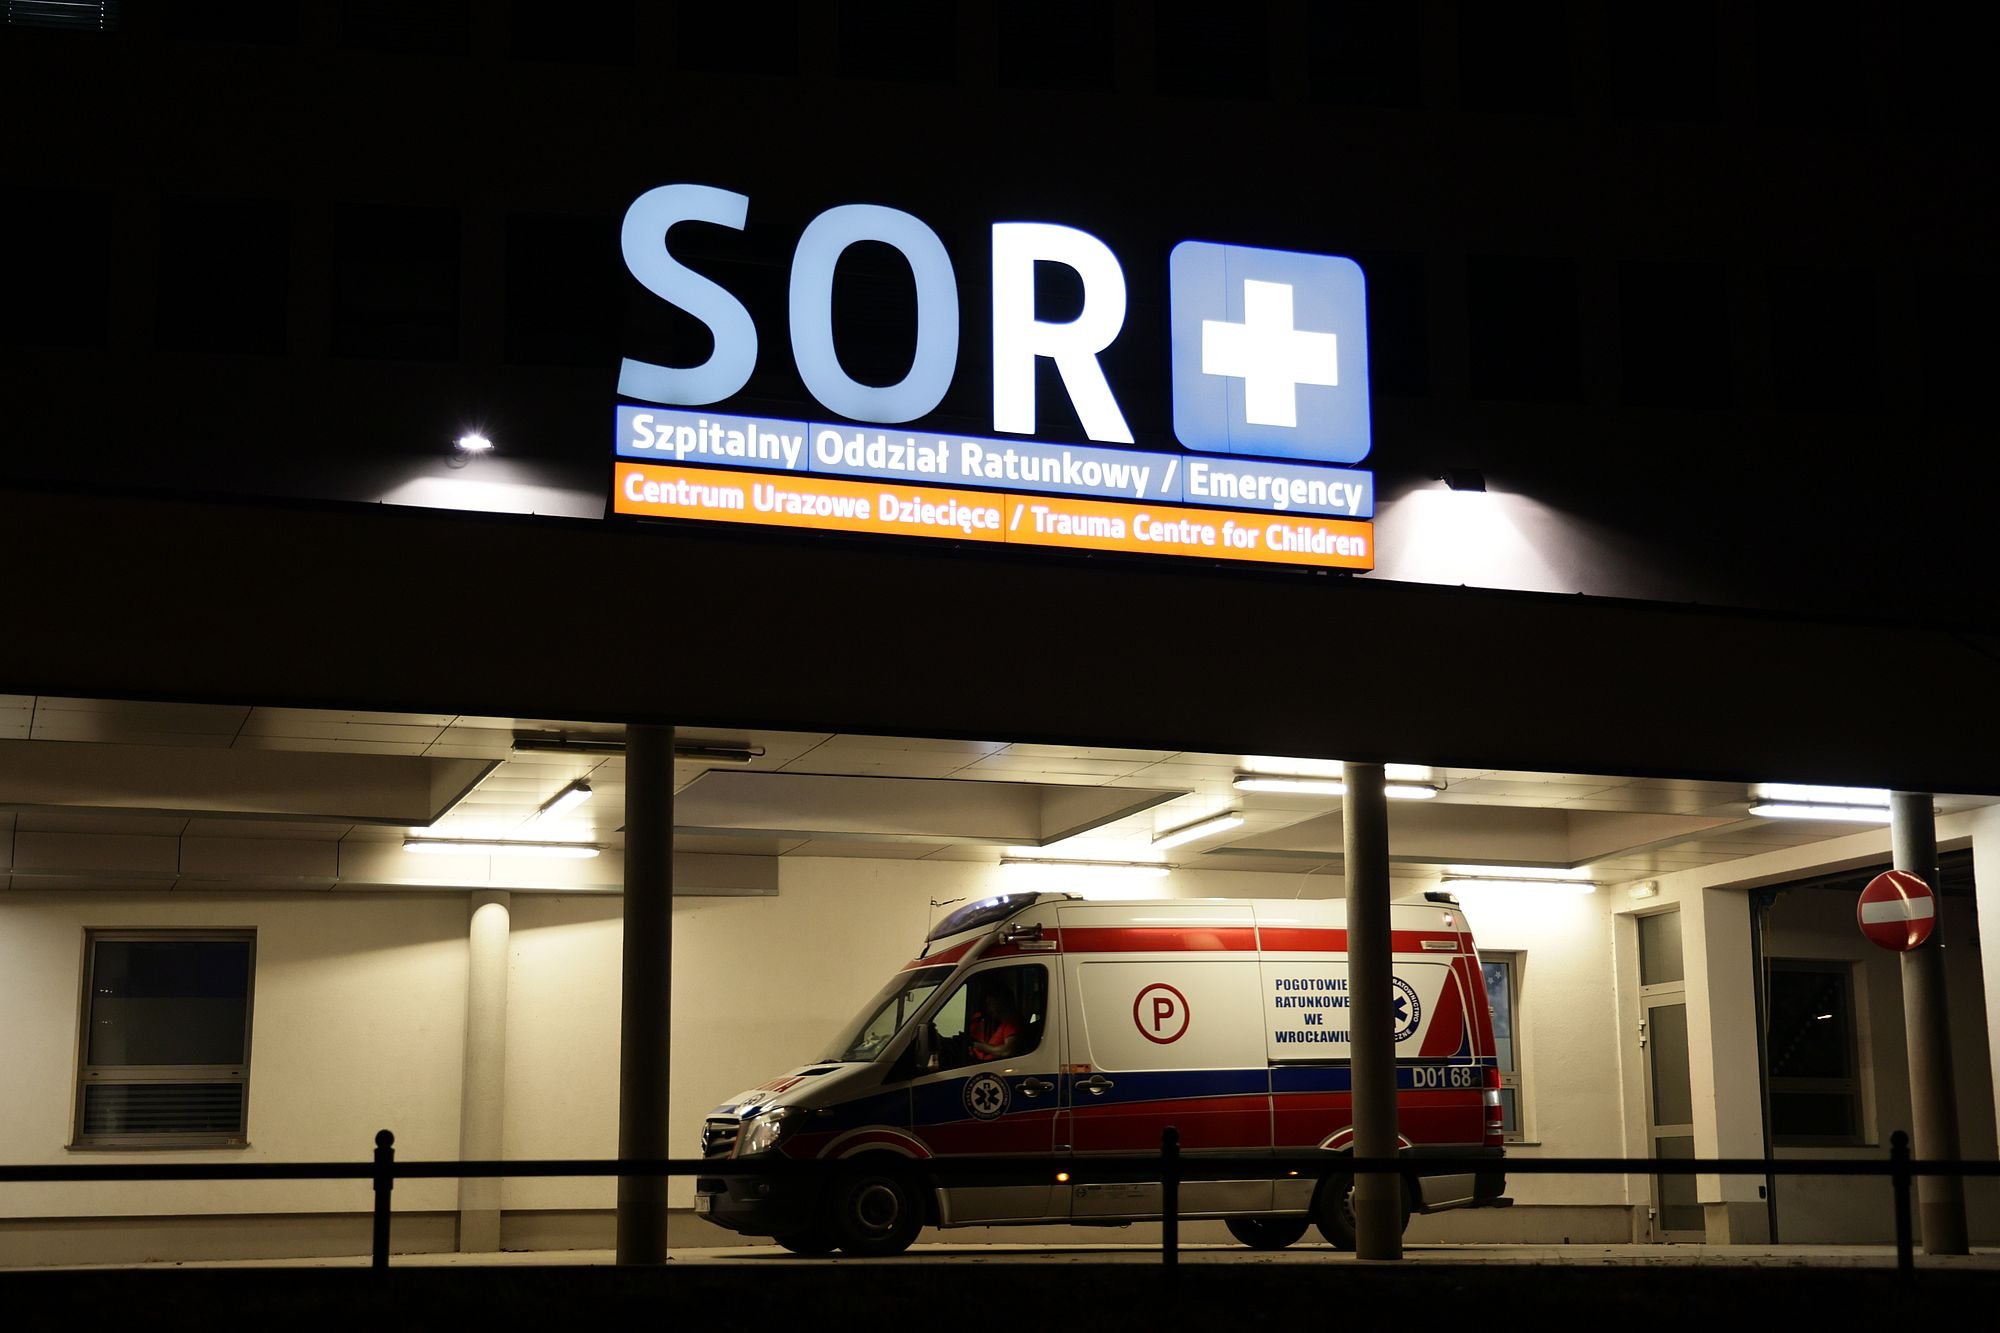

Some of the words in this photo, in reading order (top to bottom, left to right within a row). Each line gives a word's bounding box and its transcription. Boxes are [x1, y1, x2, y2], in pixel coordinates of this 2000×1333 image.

[617, 183, 1135, 444] SOR
[632, 414, 803, 469] Szpitalny
[816, 430, 950, 474] Oddział
[960, 442, 1150, 498] Ratunkowy
[1189, 462, 1363, 515] Emergency
[624, 472, 745, 510] Centrum
[753, 484, 870, 520] Urazowe
[879, 494, 1000, 534] Dziecięce
[1031, 506, 1126, 539] Trauma
[1132, 514, 1216, 545] Centre
[1222, 521, 1259, 549] for
[1265, 524, 1366, 557] Children
[1275, 979, 1348, 991] POGOTOWIE
[1275, 996, 1350, 1008] RATUNKOWE
[1153, 997, 1174, 1032] P
[1304, 1013, 1323, 1025] WE
